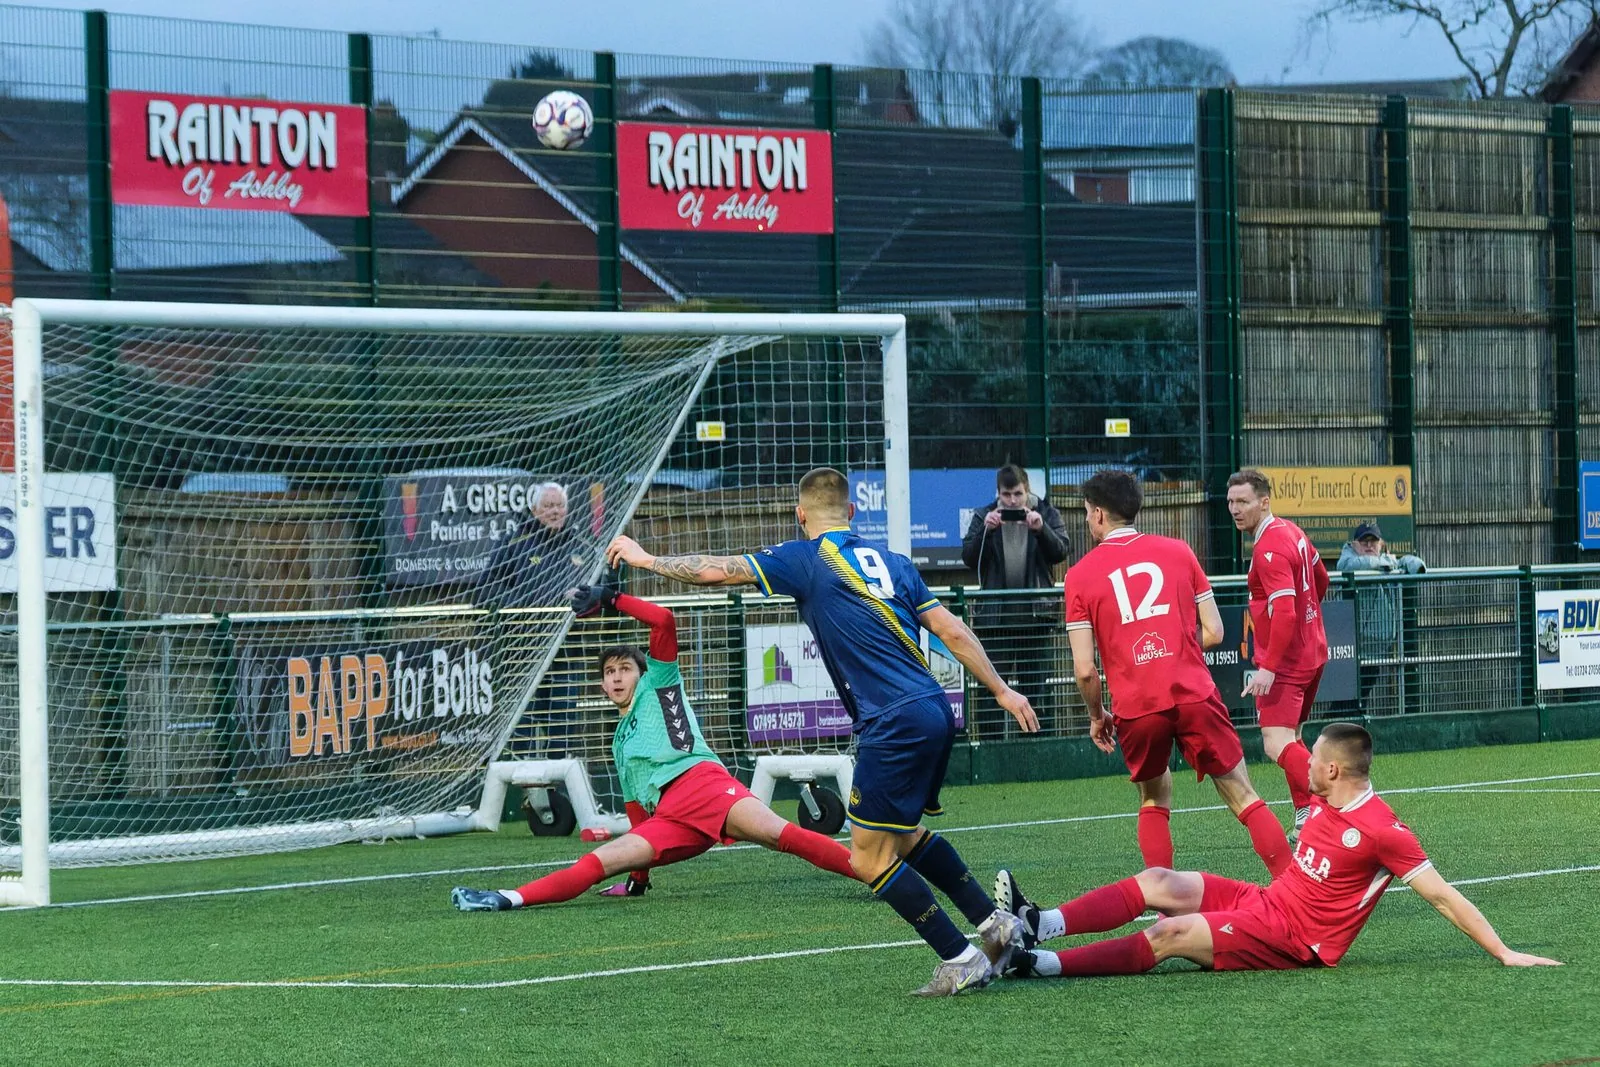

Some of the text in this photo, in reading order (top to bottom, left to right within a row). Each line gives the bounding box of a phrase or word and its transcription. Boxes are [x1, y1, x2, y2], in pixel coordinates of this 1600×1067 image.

[147, 100, 338, 169] RAINTON
[648, 131, 808, 192] RAINTON
[182, 167, 303, 208] Of Ashby
[677, 192, 779, 228] Of Ashby
[441, 484, 457, 513] A
[856, 482, 887, 512] Stir
[1310, 472, 1356, 499] Funeral
[1359, 474, 1387, 499] Care
[0, 506, 97, 558] SER
[430, 519, 484, 541] Painter
[489, 520, 501, 541] &
[395, 557, 442, 572] DOMESTIC
[853, 547, 896, 599] 9
[1107, 561, 1171, 625] 12
[803, 641, 822, 660] HO
[1137, 648, 1164, 662] HOUSE
[1215, 651, 1239, 665] 159521
[1333, 645, 1355, 660] 159521
[287, 648, 493, 757] BAPP for Bolts
